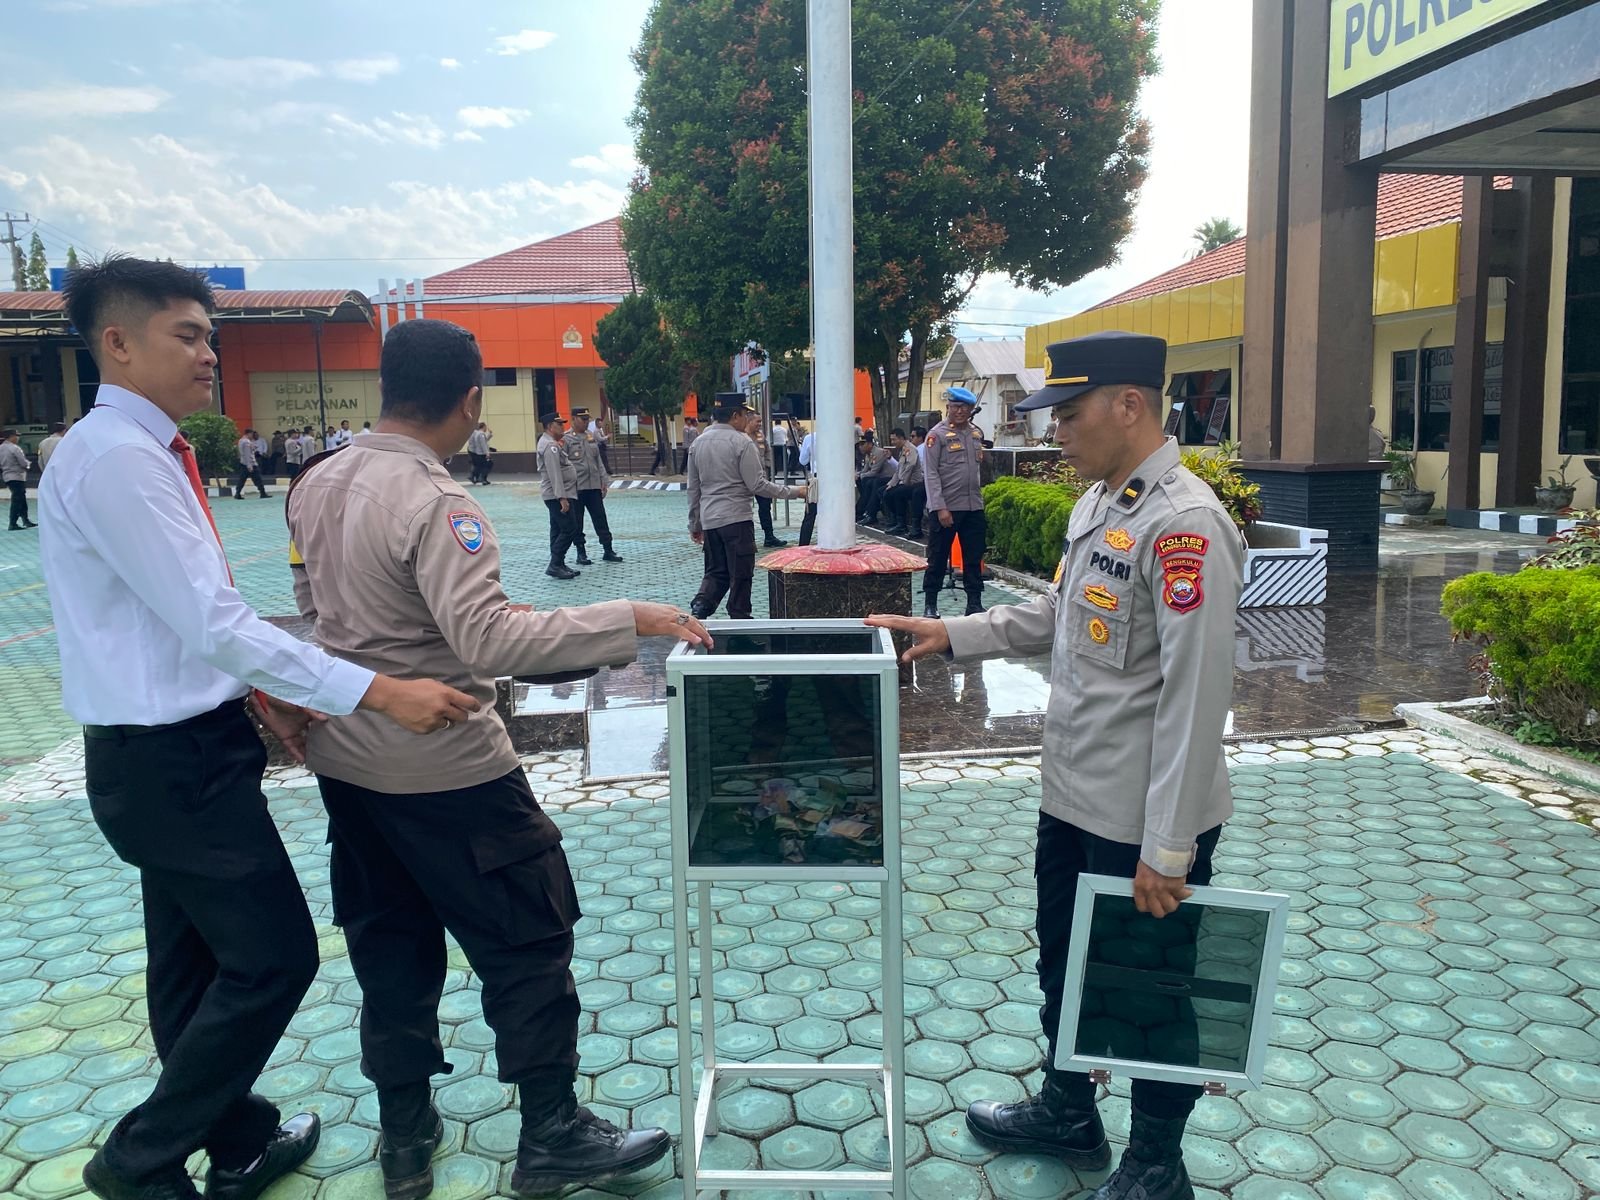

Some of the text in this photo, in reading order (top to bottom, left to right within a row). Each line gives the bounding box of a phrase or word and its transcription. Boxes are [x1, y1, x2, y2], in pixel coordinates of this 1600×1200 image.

[1344, 0, 1494, 70] POLR
[1159, 536, 1203, 549] POLRES
[1186, 543, 1202, 551] UTARA
[1090, 551, 1131, 581] POLRI
[1166, 559, 1199, 567] BENGKULU
